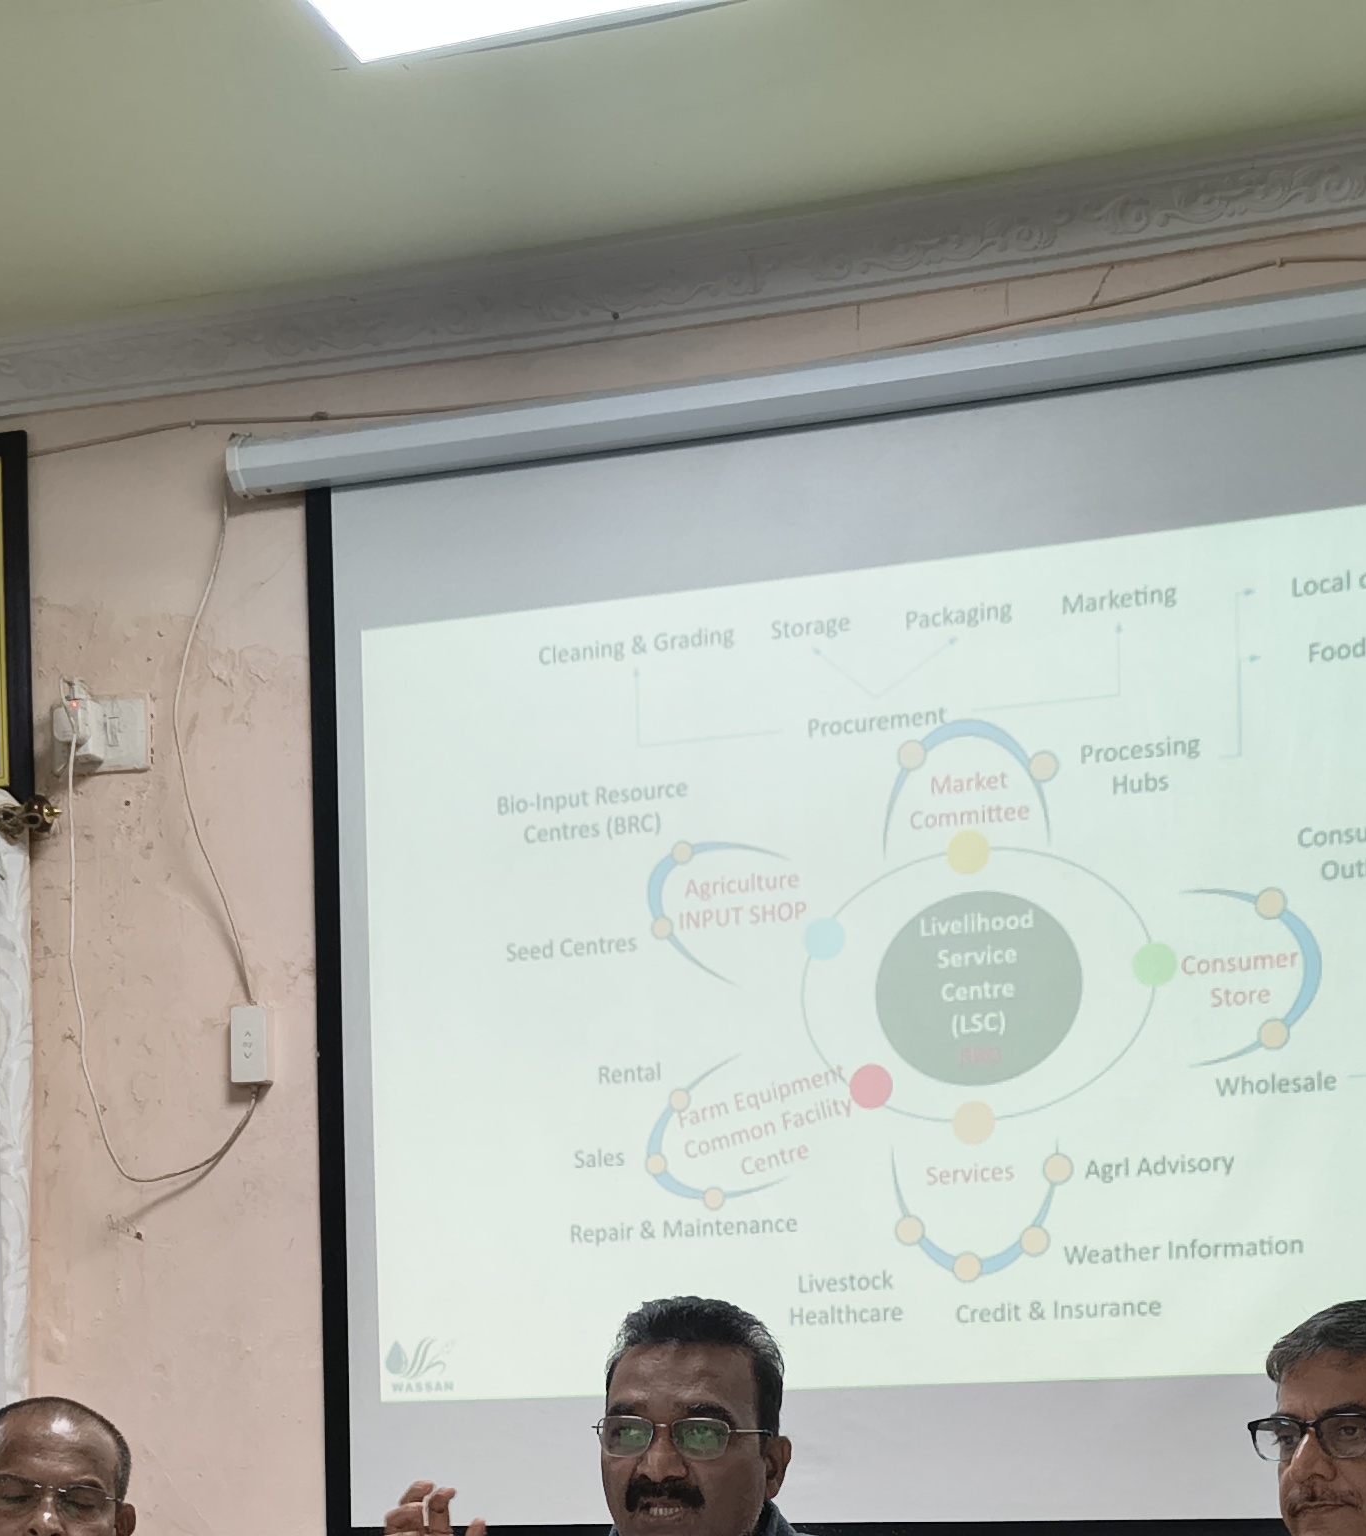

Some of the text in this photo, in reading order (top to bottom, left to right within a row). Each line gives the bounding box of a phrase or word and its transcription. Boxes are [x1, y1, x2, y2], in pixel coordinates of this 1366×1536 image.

[1291, 566, 1352, 598] Local
[1061, 582, 1178, 617] Marketing
[771, 613, 851, 641] Storage
[905, 601, 1012, 631] Packaging
[538, 625, 736, 666] Cleaning & Grading
[1307, 633, 1366, 664] Food
[808, 704, 947, 738] Procurement
[1080, 733, 1201, 767] Processing
[496, 778, 689, 817] Bio-Input Resource
[930, 770, 1009, 796] Market
[1111, 769, 1170, 797] Hubs
[523, 812, 662, 845] Centres (BRC)
[909, 803, 1031, 831] Committee
[685, 870, 801, 900] Agriculture
[679, 901, 807, 931] INPUT SHOP
[919, 910, 1034, 940] Livelihood
[505, 934, 637, 963] Seed Centres
[937, 944, 1017, 970] Service
[1181, 948, 1299, 977] Consumer
[941, 978, 1015, 1003] Centre
[1210, 982, 1272, 1009] Store
[951, 1010, 1006, 1039] (LSC)
[597, 1061, 662, 1085] Rental
[1215, 1070, 1338, 1100] Wholesale
[676, 1064, 846, 1129] Farm Equipment
[684, 1095, 854, 1160] Common Facility
[573, 1147, 625, 1171] Sales
[740, 1142, 810, 1176] Centre
[926, 1161, 1015, 1186] Services
[1085, 1150, 1236, 1184] Agri Advisory
[569, 1213, 799, 1247] Repair & Maintenance
[1063, 1233, 1305, 1267] Weather Information
[798, 1268, 894, 1294] Livestock
[789, 1302, 904, 1327] Healthcare
[955, 1296, 1162, 1326] Credit & Insurance
[391, 1381, 454, 1393] WASSAN
